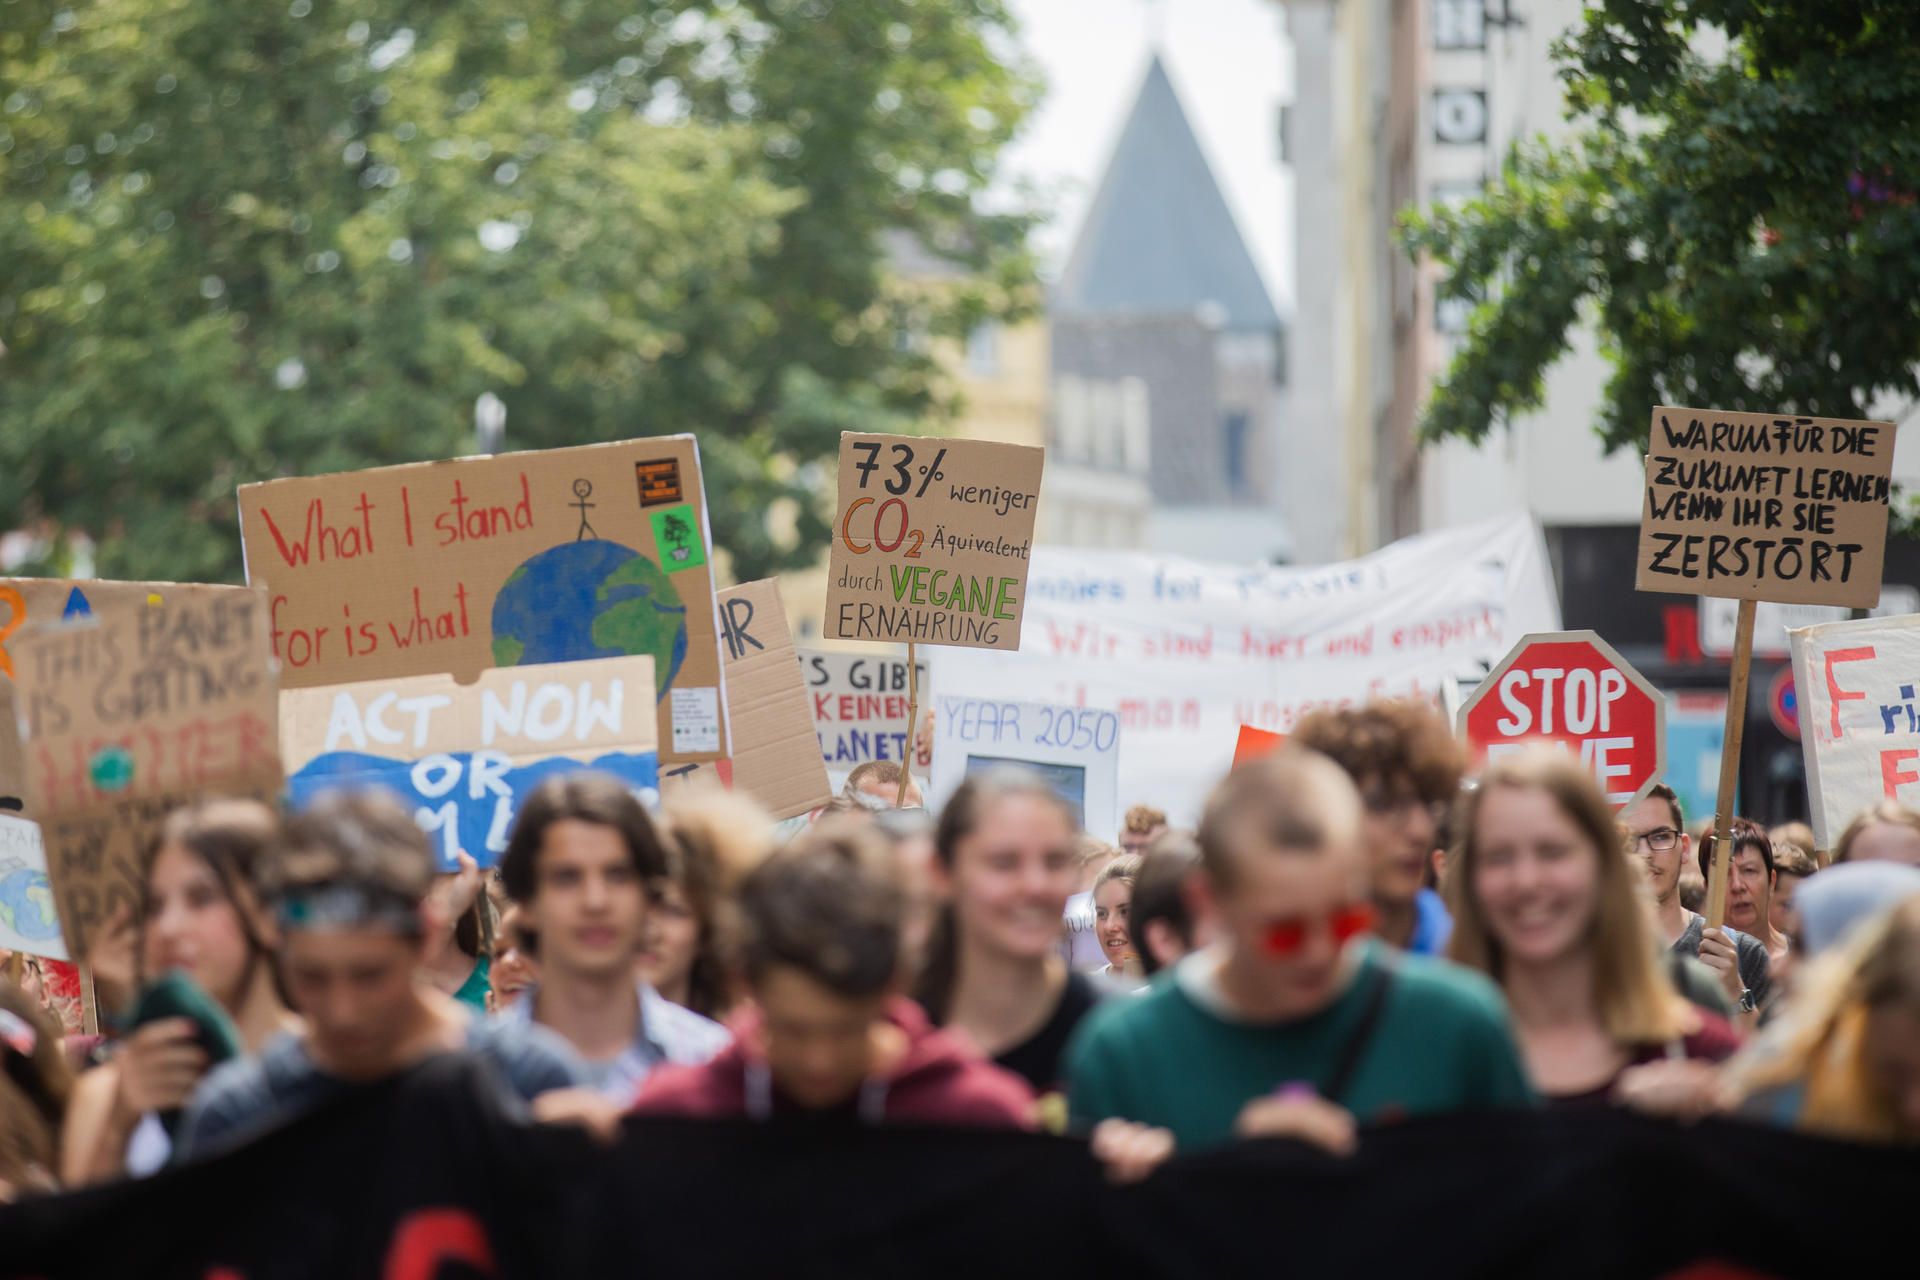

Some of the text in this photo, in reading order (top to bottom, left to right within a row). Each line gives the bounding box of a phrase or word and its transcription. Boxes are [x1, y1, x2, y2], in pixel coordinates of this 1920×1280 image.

[1661, 415, 1771, 453] WARUM
[1830, 426, 1880, 457] DIE
[852, 441, 1036, 516] 73% weniger
[1653, 456, 1791, 496] ZUKUNFT
[259, 471, 534, 568] What I stand
[1648, 486, 1837, 535] WENN IHR SIE
[930, 524, 1029, 560] Äquivalent
[1647, 531, 1864, 583] ZERSTÖRT
[837, 563, 1019, 621] durch VEGANE
[270, 581, 470, 668] for is what
[838, 602, 999, 645] ERNÄHRUNG
[802, 655, 926, 693] S GIBT
[325, 690, 453, 753] ACT
[481, 678, 625, 748] NOW
[944, 701, 1118, 752] YEAR 2050
[1496, 667, 1628, 737] STOP
[410, 749, 514, 801] OR
